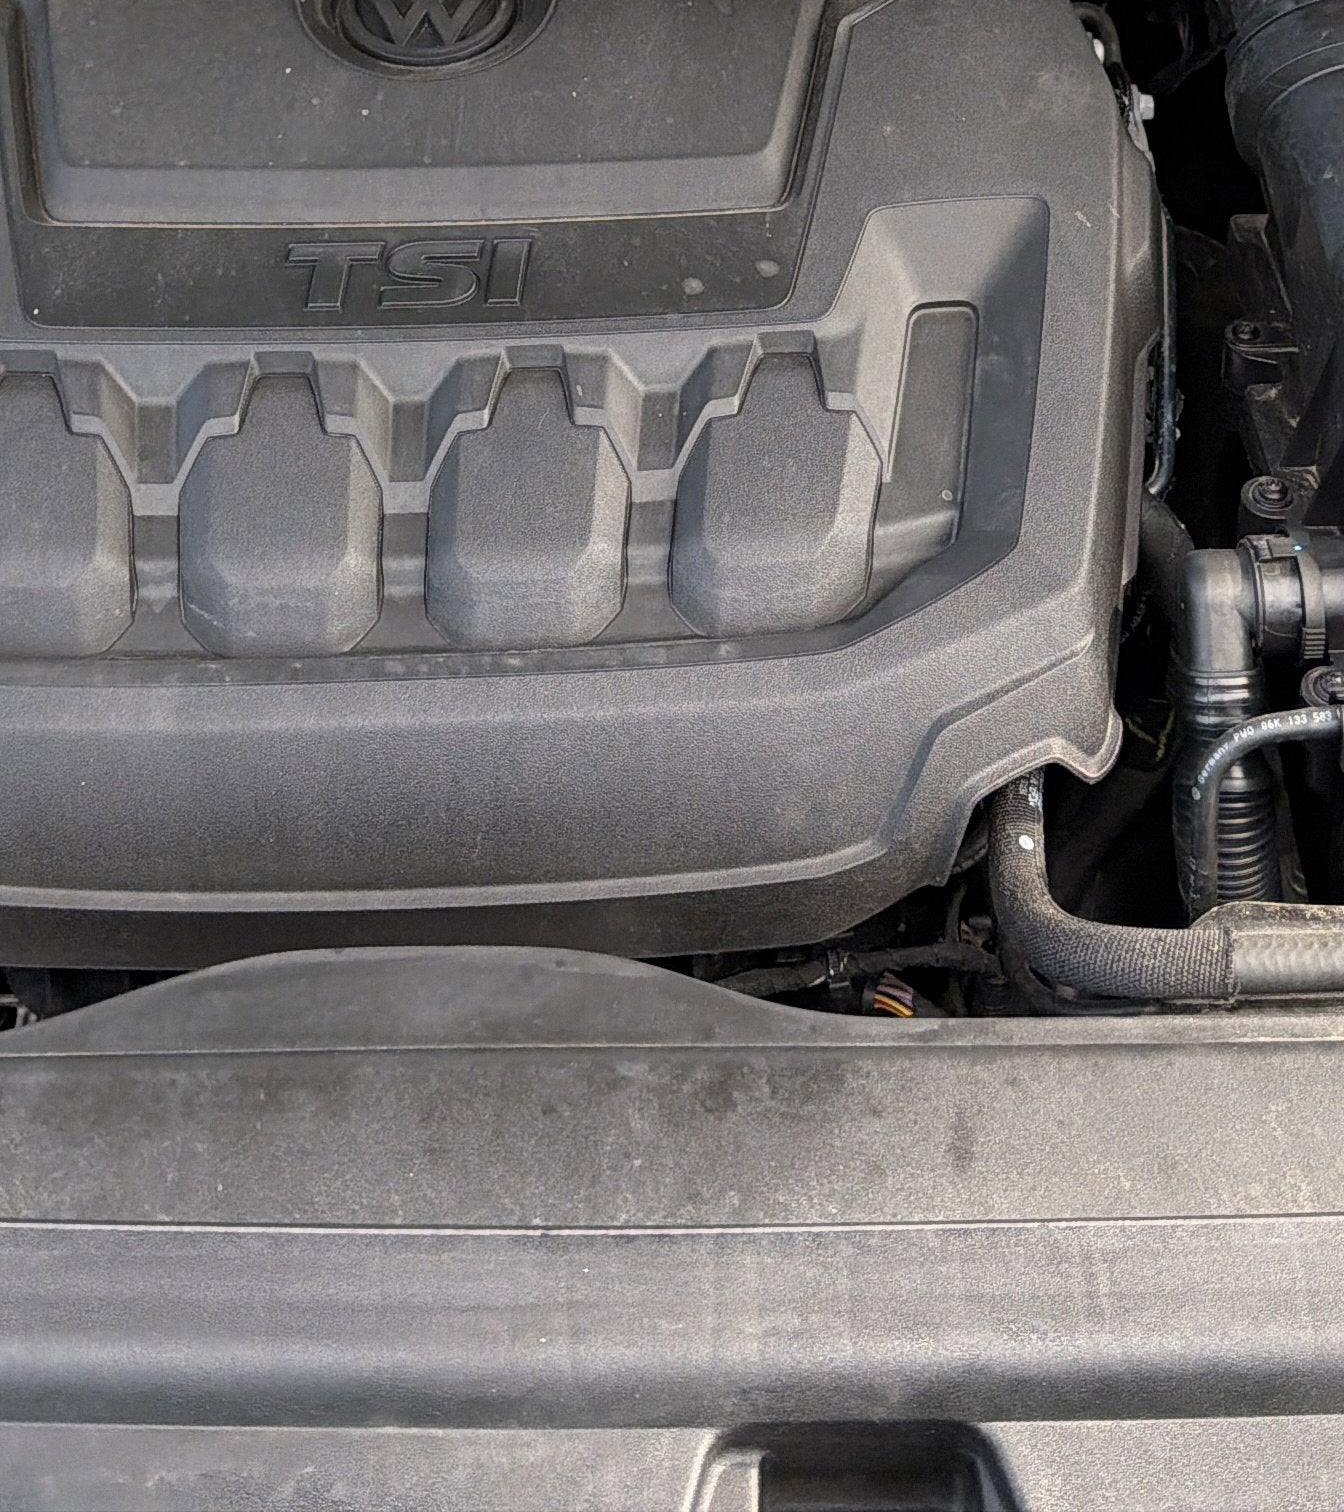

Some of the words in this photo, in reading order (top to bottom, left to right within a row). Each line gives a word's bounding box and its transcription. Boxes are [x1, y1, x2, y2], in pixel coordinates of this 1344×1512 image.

[284, 237, 534, 311] TSI
[1197, 743, 1229, 784] Germany
[1260, 718, 1282, 731] 06K
[1288, 714, 1308, 726] 133
